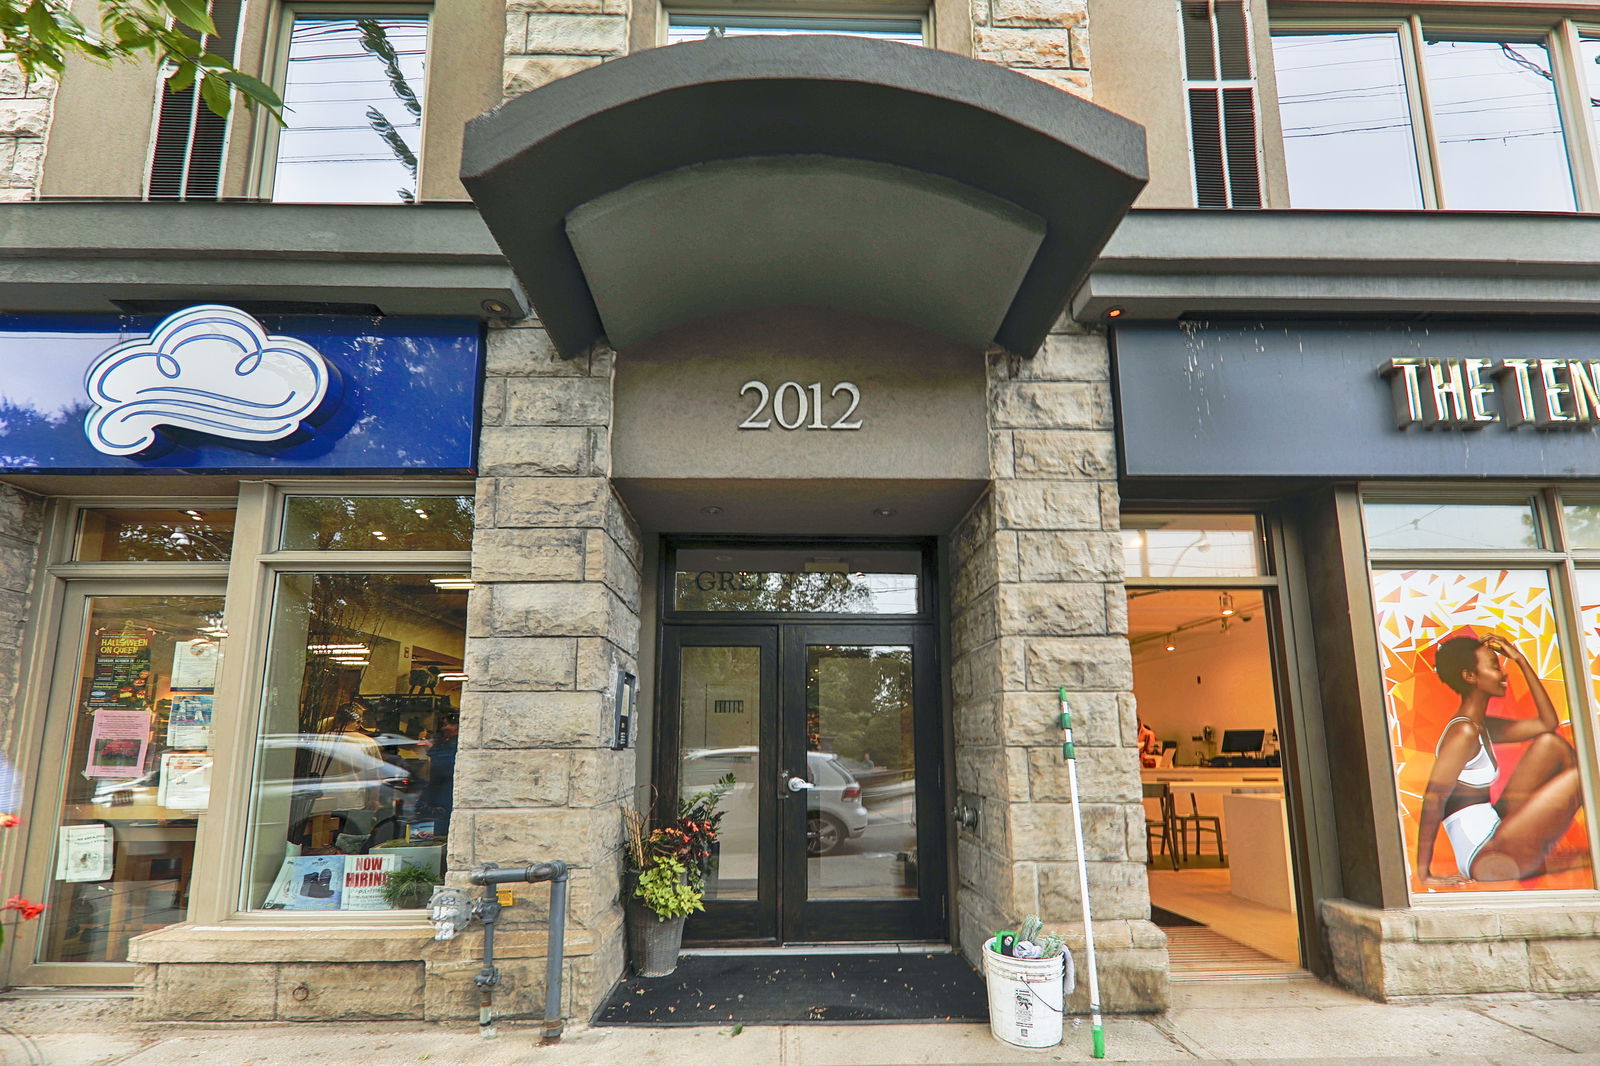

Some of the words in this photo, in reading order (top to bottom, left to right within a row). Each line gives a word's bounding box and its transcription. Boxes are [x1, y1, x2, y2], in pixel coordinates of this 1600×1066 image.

[1391, 357, 1500, 422] THE
[1503, 357, 1600, 422] TEN
[738, 380, 864, 430] 2012
[100, 646, 113, 654] ON
[101, 638, 149, 647] HALLOWEEN
[356, 856, 383, 871] NOW
